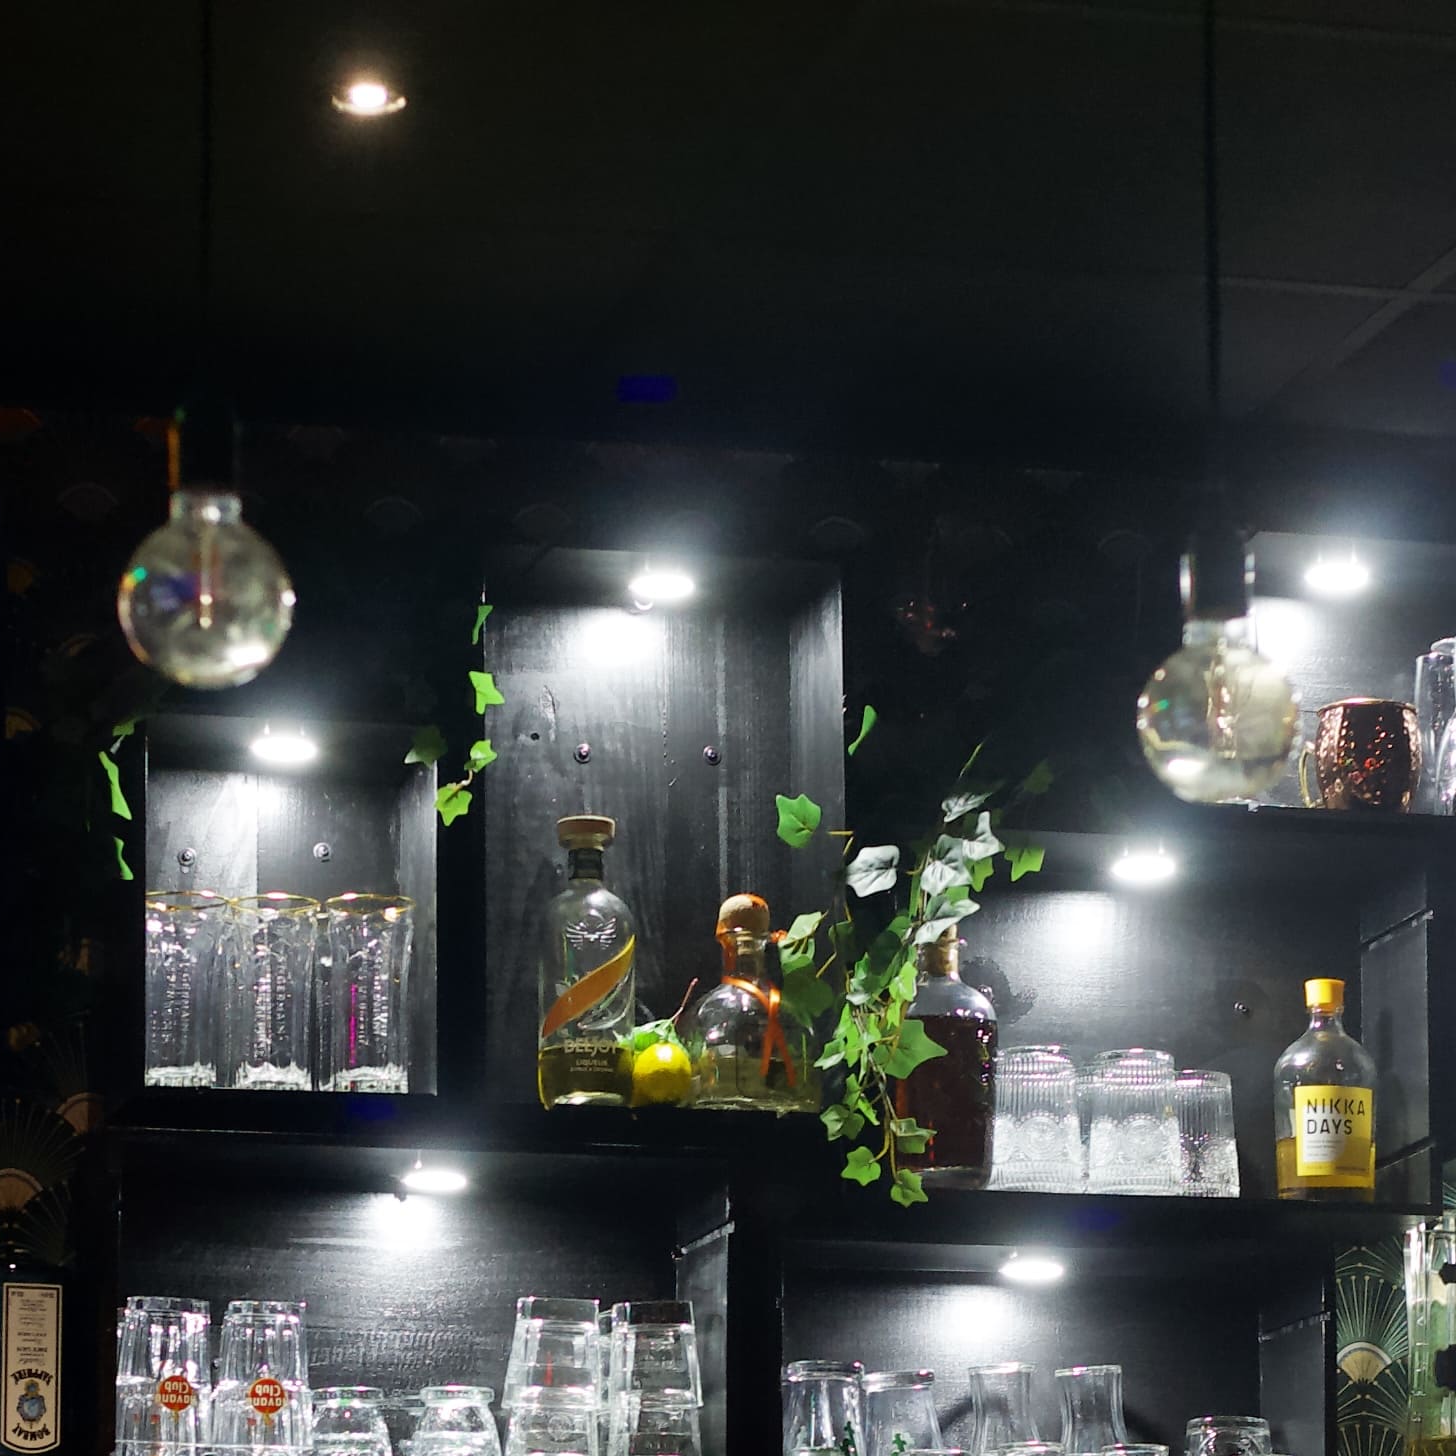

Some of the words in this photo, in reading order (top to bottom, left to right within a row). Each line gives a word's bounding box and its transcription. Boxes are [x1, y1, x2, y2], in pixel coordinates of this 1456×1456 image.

[1306, 1097, 1366, 1117] NIKKA
[1306, 1118, 1354, 1136] DAYS
[10, 1367, 54, 1386] SAPPHIRE
[162, 1380, 190, 1394] Club
[254, 1383, 281, 1398] Club
[12, 1423, 52, 1442] BOMBAY
